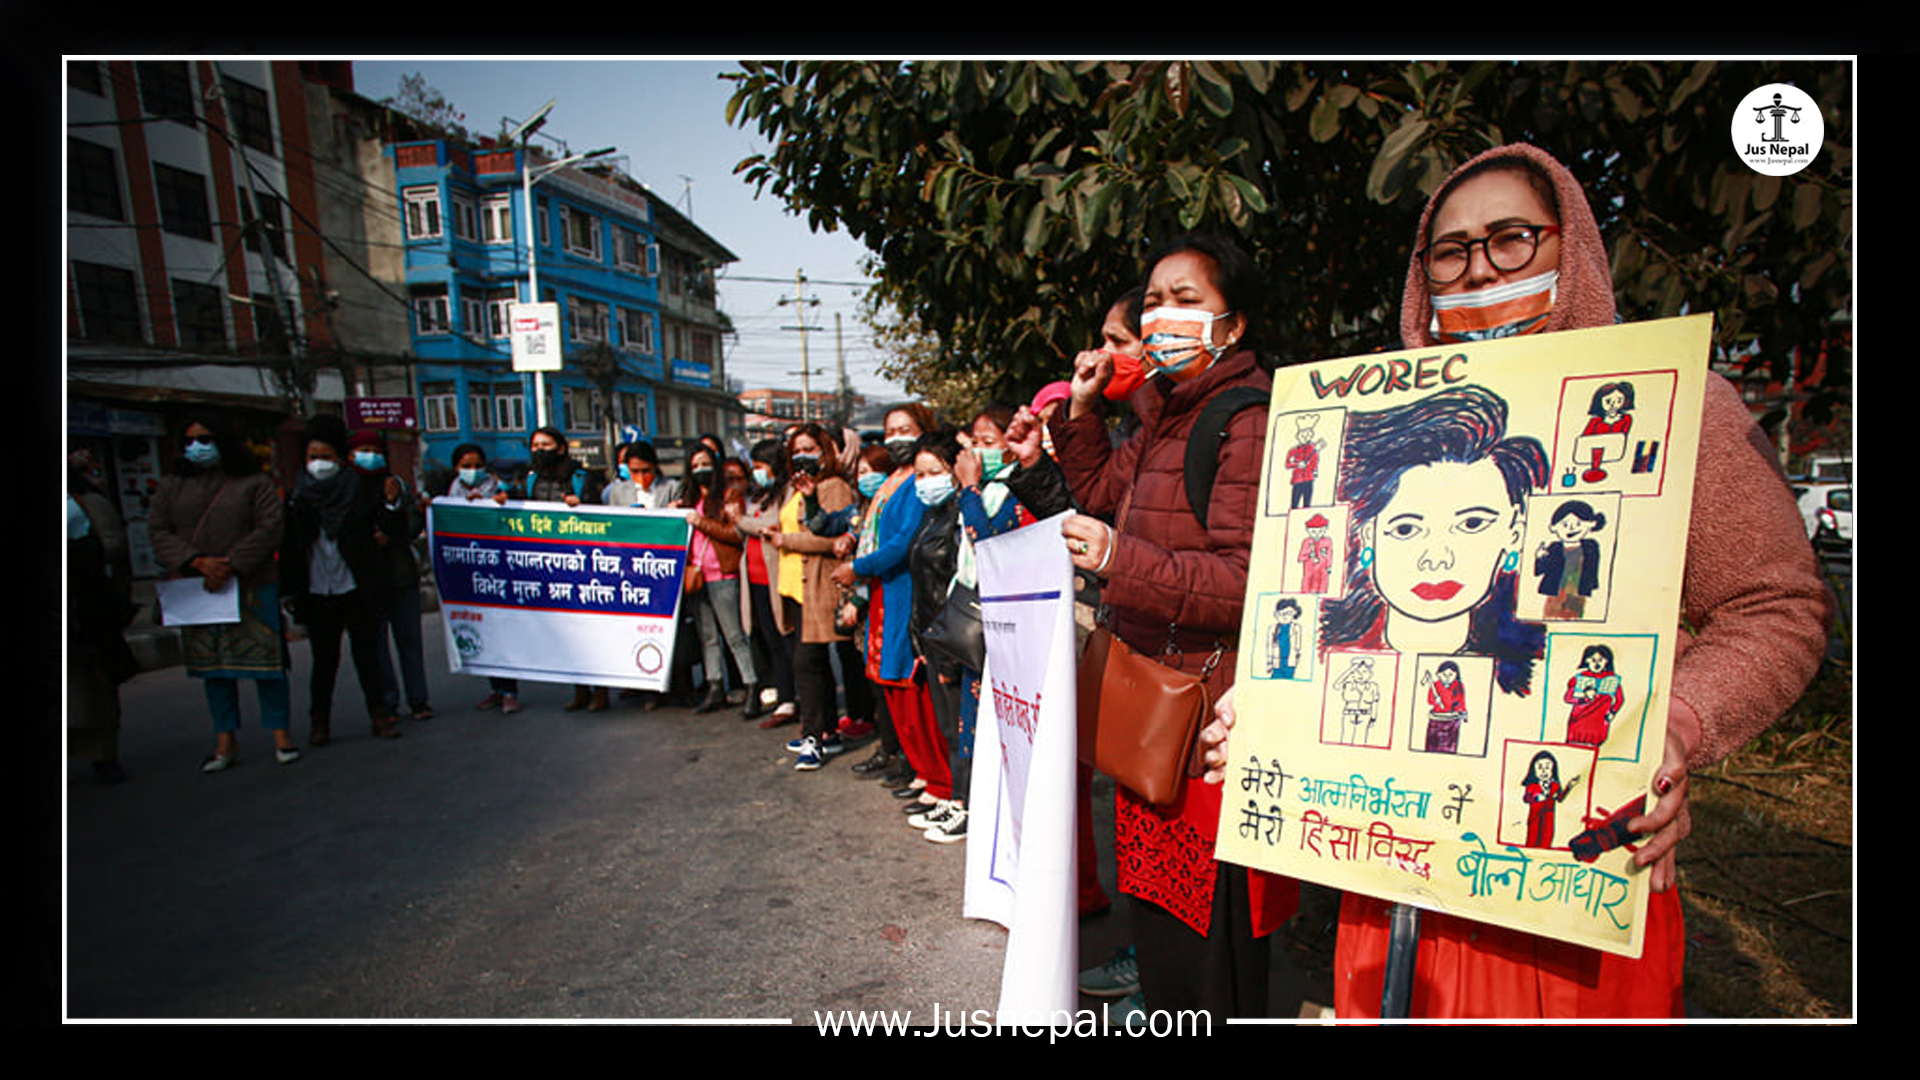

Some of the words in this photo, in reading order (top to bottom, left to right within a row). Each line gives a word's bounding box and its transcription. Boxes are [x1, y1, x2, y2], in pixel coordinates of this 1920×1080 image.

[1310, 353, 1468, 399] WOREC
[441, 541, 501, 566] सामाजिक
[505, 548, 587, 574] रुपान्तरणको
[591, 548, 625, 578] चित्र,
[631, 551, 678, 579] महिला
[472, 571, 507, 600] विभेद
[512, 580, 542, 604] मुक्त
[548, 582, 573, 601] श्रम
[578, 578, 615, 605] शक्ति
[621, 580, 651, 606] भित्र
[1241, 755, 1294, 798] मेरो
[1299, 774, 1432, 819] आत्मनिर्भरता
[1442, 784, 1474, 825] नै
[1239, 799, 1285, 846] मेरो
[1300, 809, 1362, 861] हिंसा
[1457, 832, 1534, 901] बोल्ने
[1529, 862, 1631, 930] आधार
